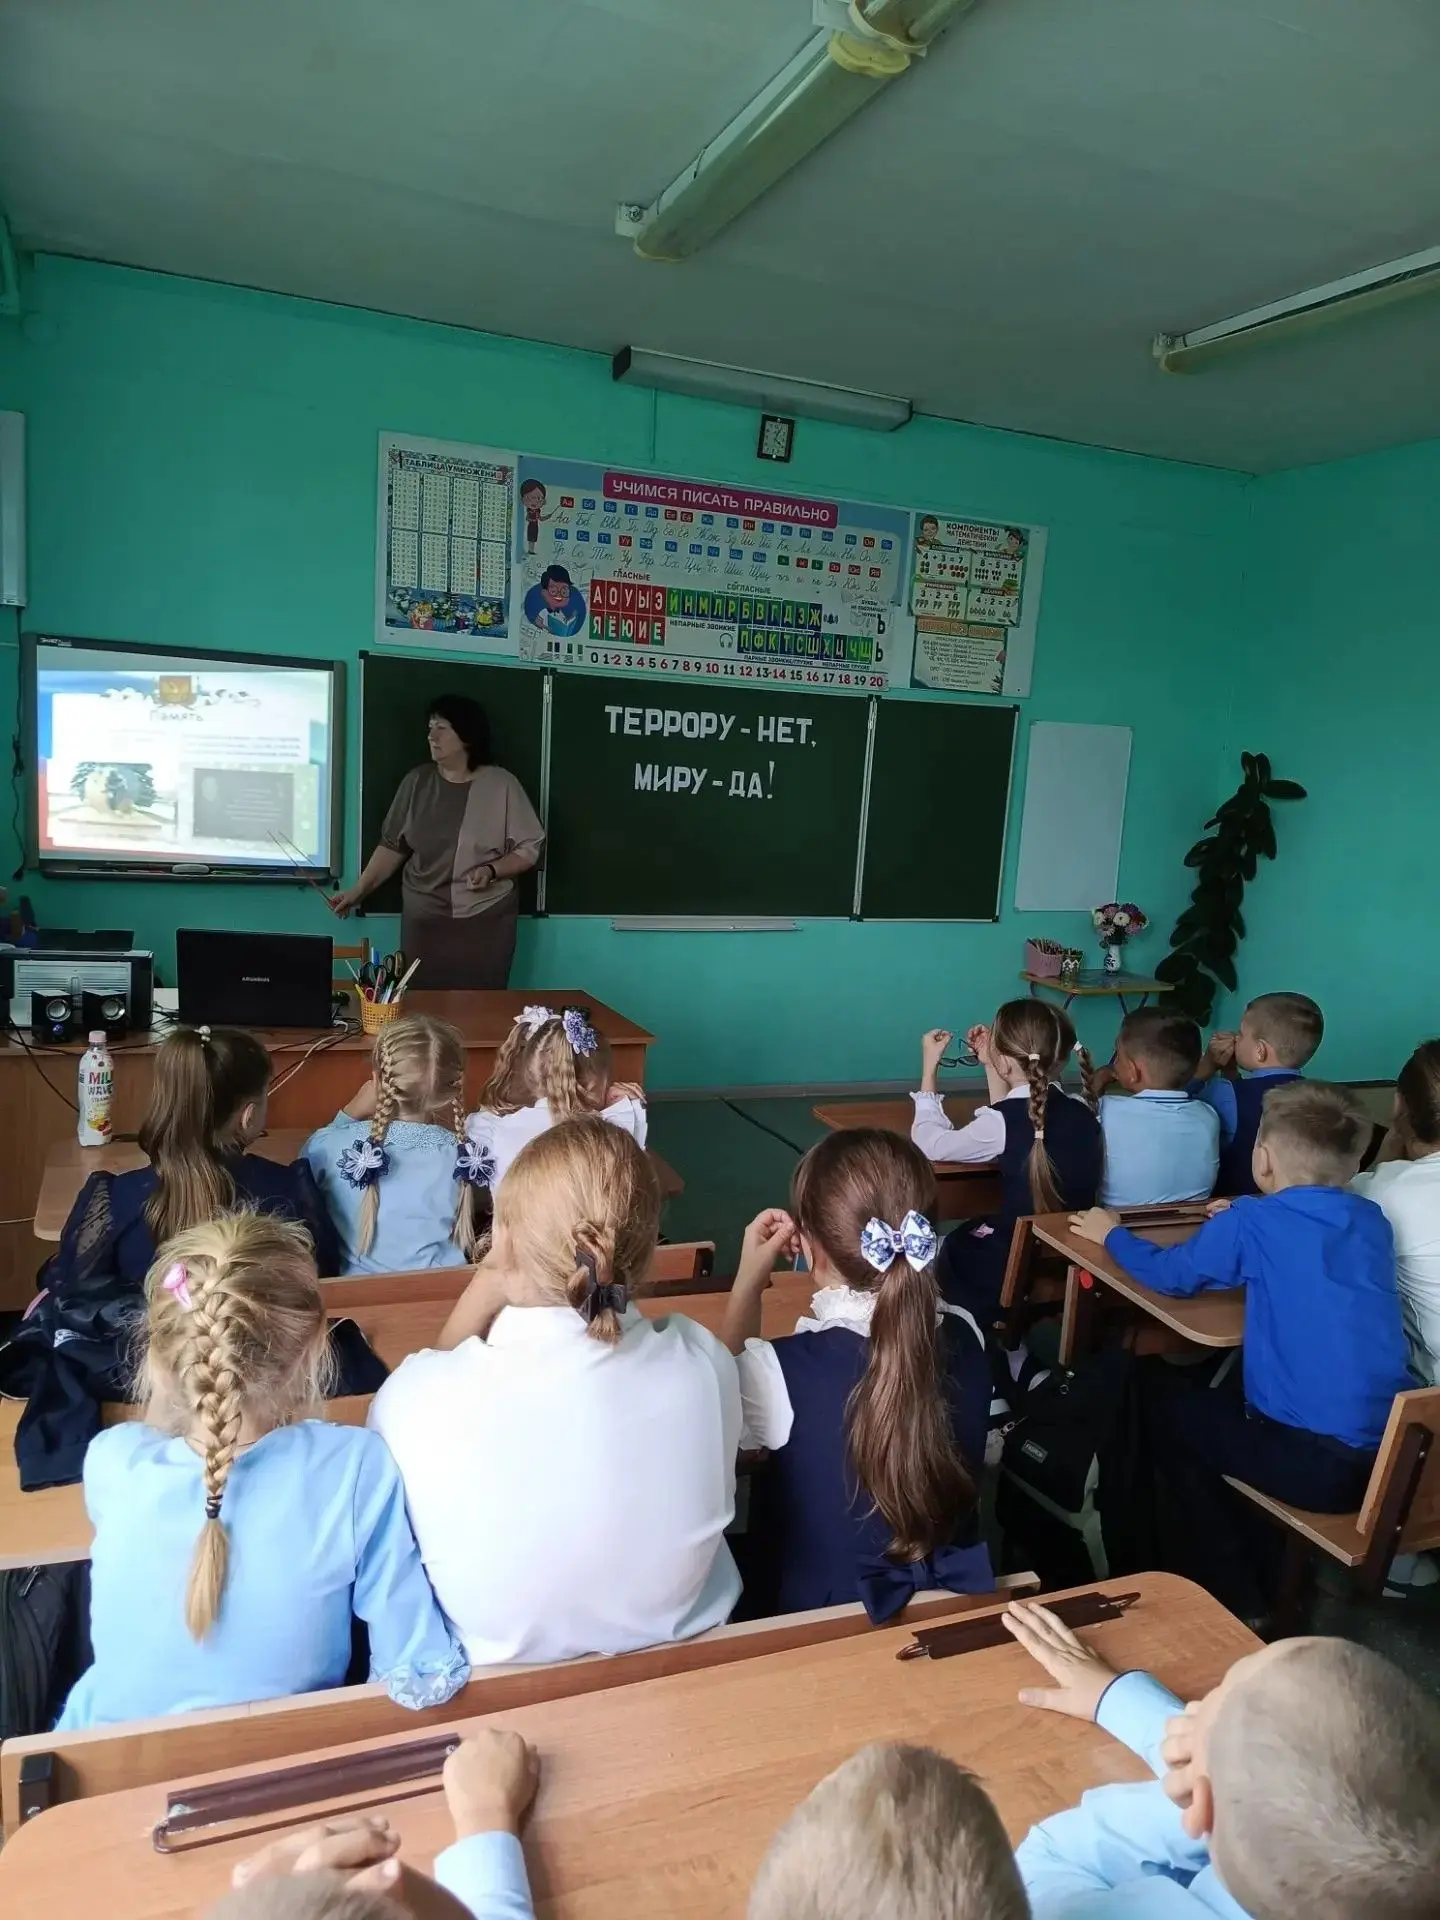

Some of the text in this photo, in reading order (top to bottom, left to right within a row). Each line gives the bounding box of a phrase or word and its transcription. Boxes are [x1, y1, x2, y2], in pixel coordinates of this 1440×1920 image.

[405, 458, 503, 481] ТАБЛИЦА УМНОЖЕНИ
[612, 479, 829, 522] УЧИМСЯ ПИСАТЬ ПРАВИЛЬНО
[946, 522, 999, 536] КОМПОНЕНТЫ
[613, 570, 651, 581] ГЛАСНЫЕ
[592, 585, 663, 611] А О У Ы Э
[726, 583, 772, 594] СОГЛАСНЫЕ
[684, 595, 694, 613] Н
[727, 600, 736, 618] Р
[742, 601, 750, 619] Б
[756, 603, 764, 621] В
[784, 605, 792, 624] Д
[809, 608, 820, 627] Ж
[592, 616, 662, 640] Я Ё Ю И Е
[669, 619, 705, 629] НЕПАРНЫЕ
[707, 622, 736, 632] ЗВОНКИЕ
[753, 631, 764, 649] Ф
[768, 632, 777, 650] К
[591, 652, 598, 663] 0
[603, 654, 609, 664] 1
[614, 654, 621, 665] 2
[625, 655, 632, 666] 3
[637, 657, 645, 667] 4
[649, 657, 656, 668] 5
[660, 659, 668, 669] 6
[672, 660, 679, 670] 7
[683, 661, 690, 671] 8
[694, 662, 701, 672] 9
[706, 663, 719, 673] 10
[723, 664, 735, 675] 11
[740, 666, 752, 676] 12
[756, 667, 769, 678] 13
[773, 669, 786, 680] 14
[790, 670, 802, 681] 15
[806, 671, 819, 682] 16
[823, 672, 834, 683] 17
[838, 674, 850, 684] 18
[854, 675, 866, 686] 19
[869, 676, 883, 687] 20
[604, 705, 736, 741] ТЕРРОРУ
[633, 762, 708, 795] МИРУ
[728, 760, 775, 800] ДА!
